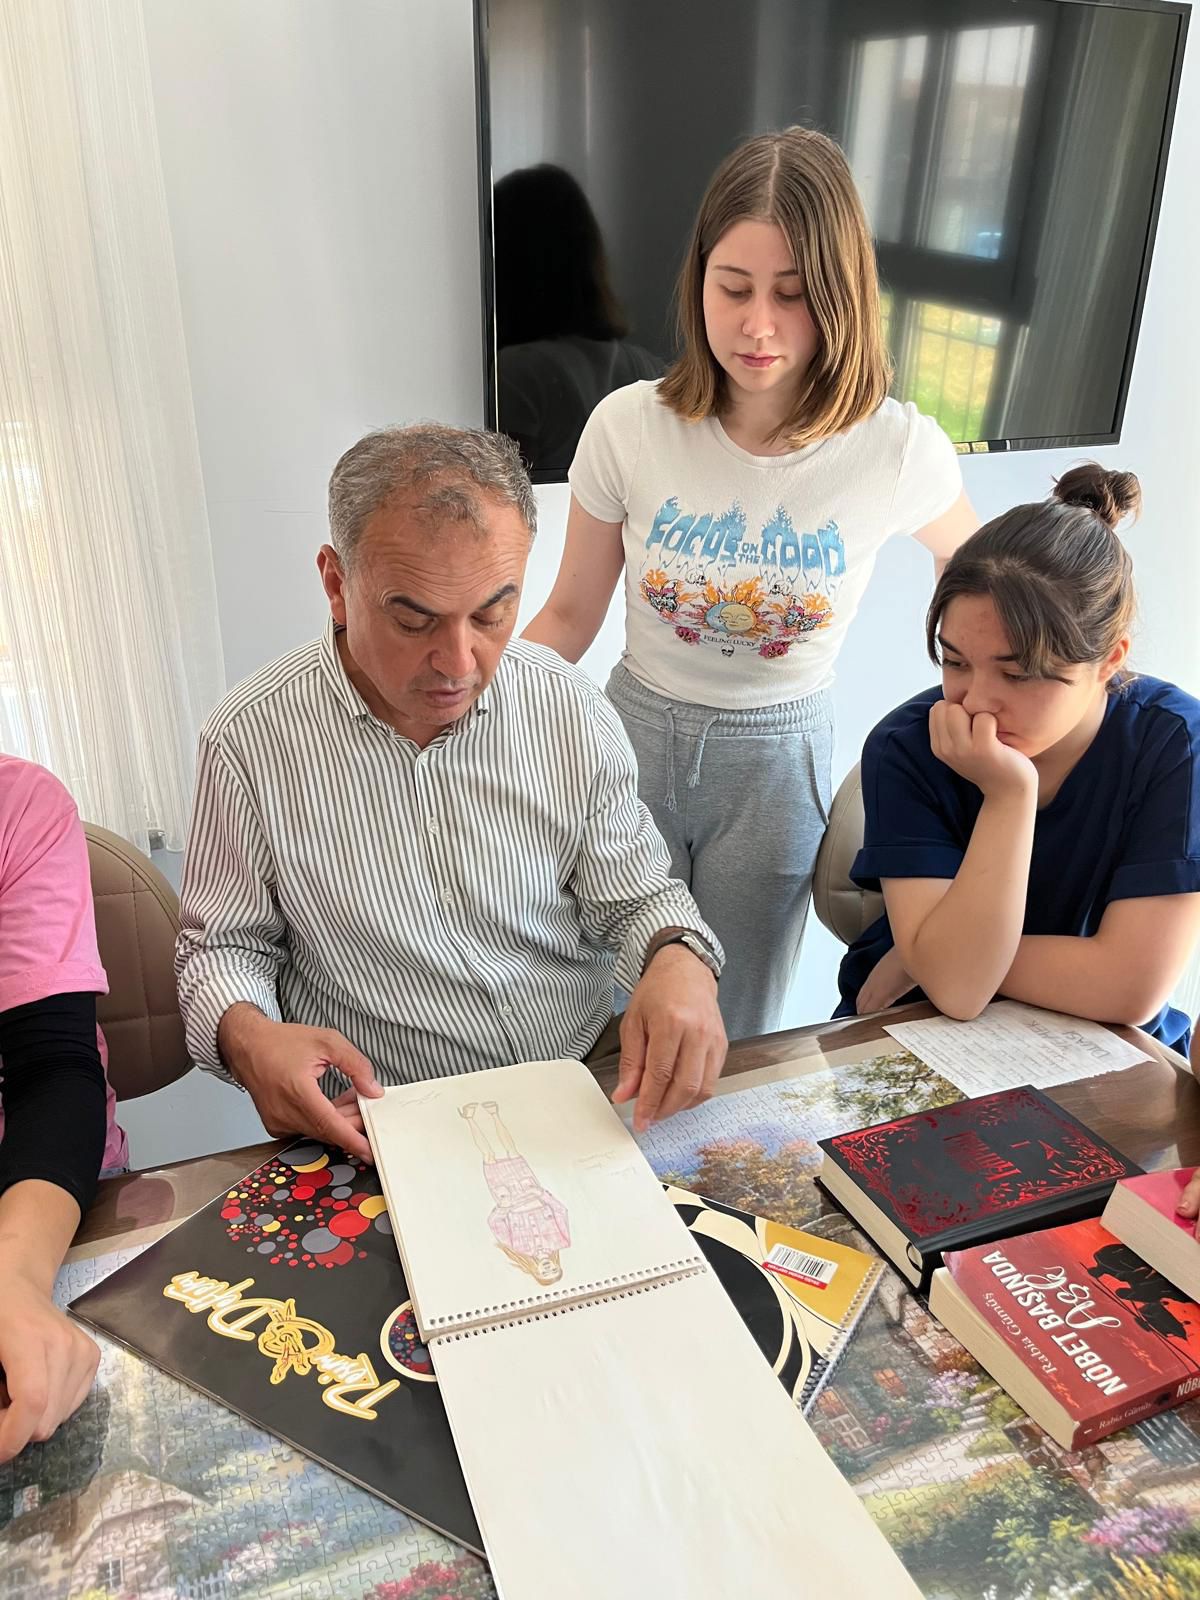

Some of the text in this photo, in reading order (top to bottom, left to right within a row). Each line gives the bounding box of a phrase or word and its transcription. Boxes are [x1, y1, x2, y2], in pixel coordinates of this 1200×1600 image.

[644, 496, 747, 569] FOCUS
[737, 553, 761, 565] THE
[742, 542, 759, 553] ON
[703, 634, 756, 648] FEELING LUCKY
[981, 1250, 1065, 1330] BAŞINDA
[984, 1292, 1058, 1374] Rabia Gümüş
[1051, 1331, 1128, 1396] NÖBET
[309, 1352, 400, 1420] Resim
[1176, 1376, 1200, 1398] NÖB
